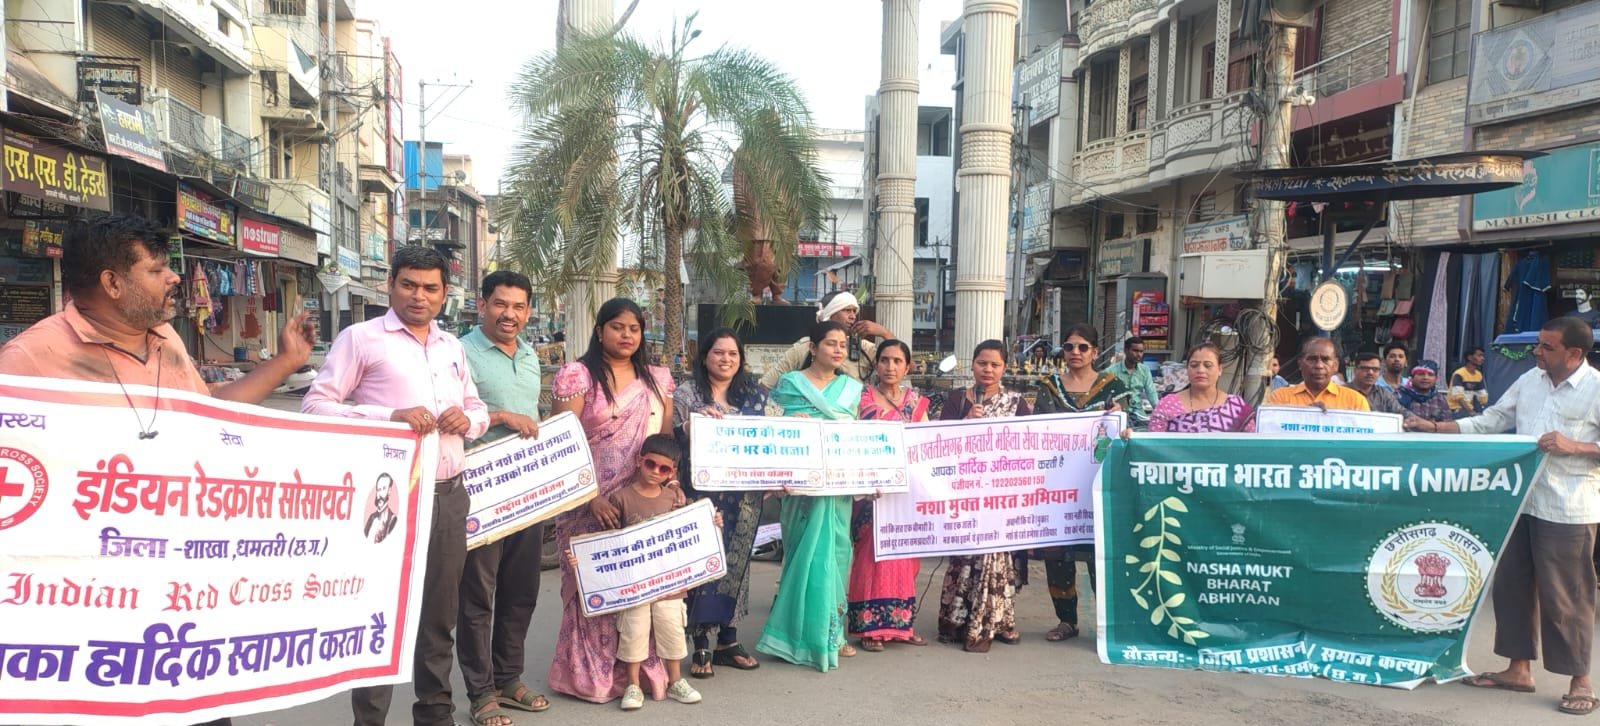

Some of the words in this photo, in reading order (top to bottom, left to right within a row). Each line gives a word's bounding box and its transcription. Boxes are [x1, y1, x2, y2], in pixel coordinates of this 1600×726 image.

[1485, 213, 1558, 228] MAHESH
[243, 225, 279, 246] nostrum
[219, 428, 245, 447] सेवा
[737, 427, 758, 438] पल
[760, 425, 775, 438] की
[777, 429, 801, 439] नशा
[995, 425, 1021, 456] महिला
[1022, 425, 1039, 451] सेवा
[743, 445, 759, 455] भर
[762, 443, 777, 455] की
[462, 460, 493, 481] जिसने
[495, 453, 513, 468] नशे
[514, 447, 526, 462] को
[958, 455, 987, 476] हार्दिक
[990, 455, 1035, 474] अभिनंदन
[1058, 454, 1065, 468] है
[1129, 460, 1228, 495] नशामुक्त
[1233, 463, 1291, 489] भारत
[1299, 457, 1403, 492] अभियान
[1408, 463, 1524, 497] (NMBA)
[30, 464, 46, 507] SOCIETY
[73, 452, 191, 521] इंडियन
[195, 461, 276, 521] रेडक्रॉस
[277, 469, 356, 521] सोसायटी
[915, 499, 946, 516] नशा
[949, 497, 980, 519] मुक्त
[983, 494, 1018, 511] भारत
[1022, 487, 1079, 506] अभियान
[99, 526, 168, 559] जिला
[590, 551, 609, 561] जन
[612, 546, 629, 558] जन
[631, 539, 645, 552] की
[646, 536, 656, 547] हो
[657, 528, 674, 542] यही
[675, 521, 698, 539] पुकार
[1448, 530, 1482, 555] शासन
[595, 562, 617, 574] नशा
[647, 550, 664, 561] अब
[665, 543, 677, 554] की
[1187, 562, 1242, 576] NASHA
[1245, 564, 1293, 578] MUKT
[2, 571, 138, 610] Indian
[162, 580, 219, 612] Red
[229, 576, 293, 606] Cross
[302, 572, 365, 601] Society
[1207, 578, 1272, 592] BHARAT
[1198, 593, 1280, 606] ABHIYAAN
[85, 622, 226, 688] हार्दिक
[228, 627, 317, 677] स्वागत
[319, 625, 366, 662] करता
[370, 612, 387, 656] है
[1198, 648, 1242, 666] जिला
[1321, 647, 1375, 667] समाज
